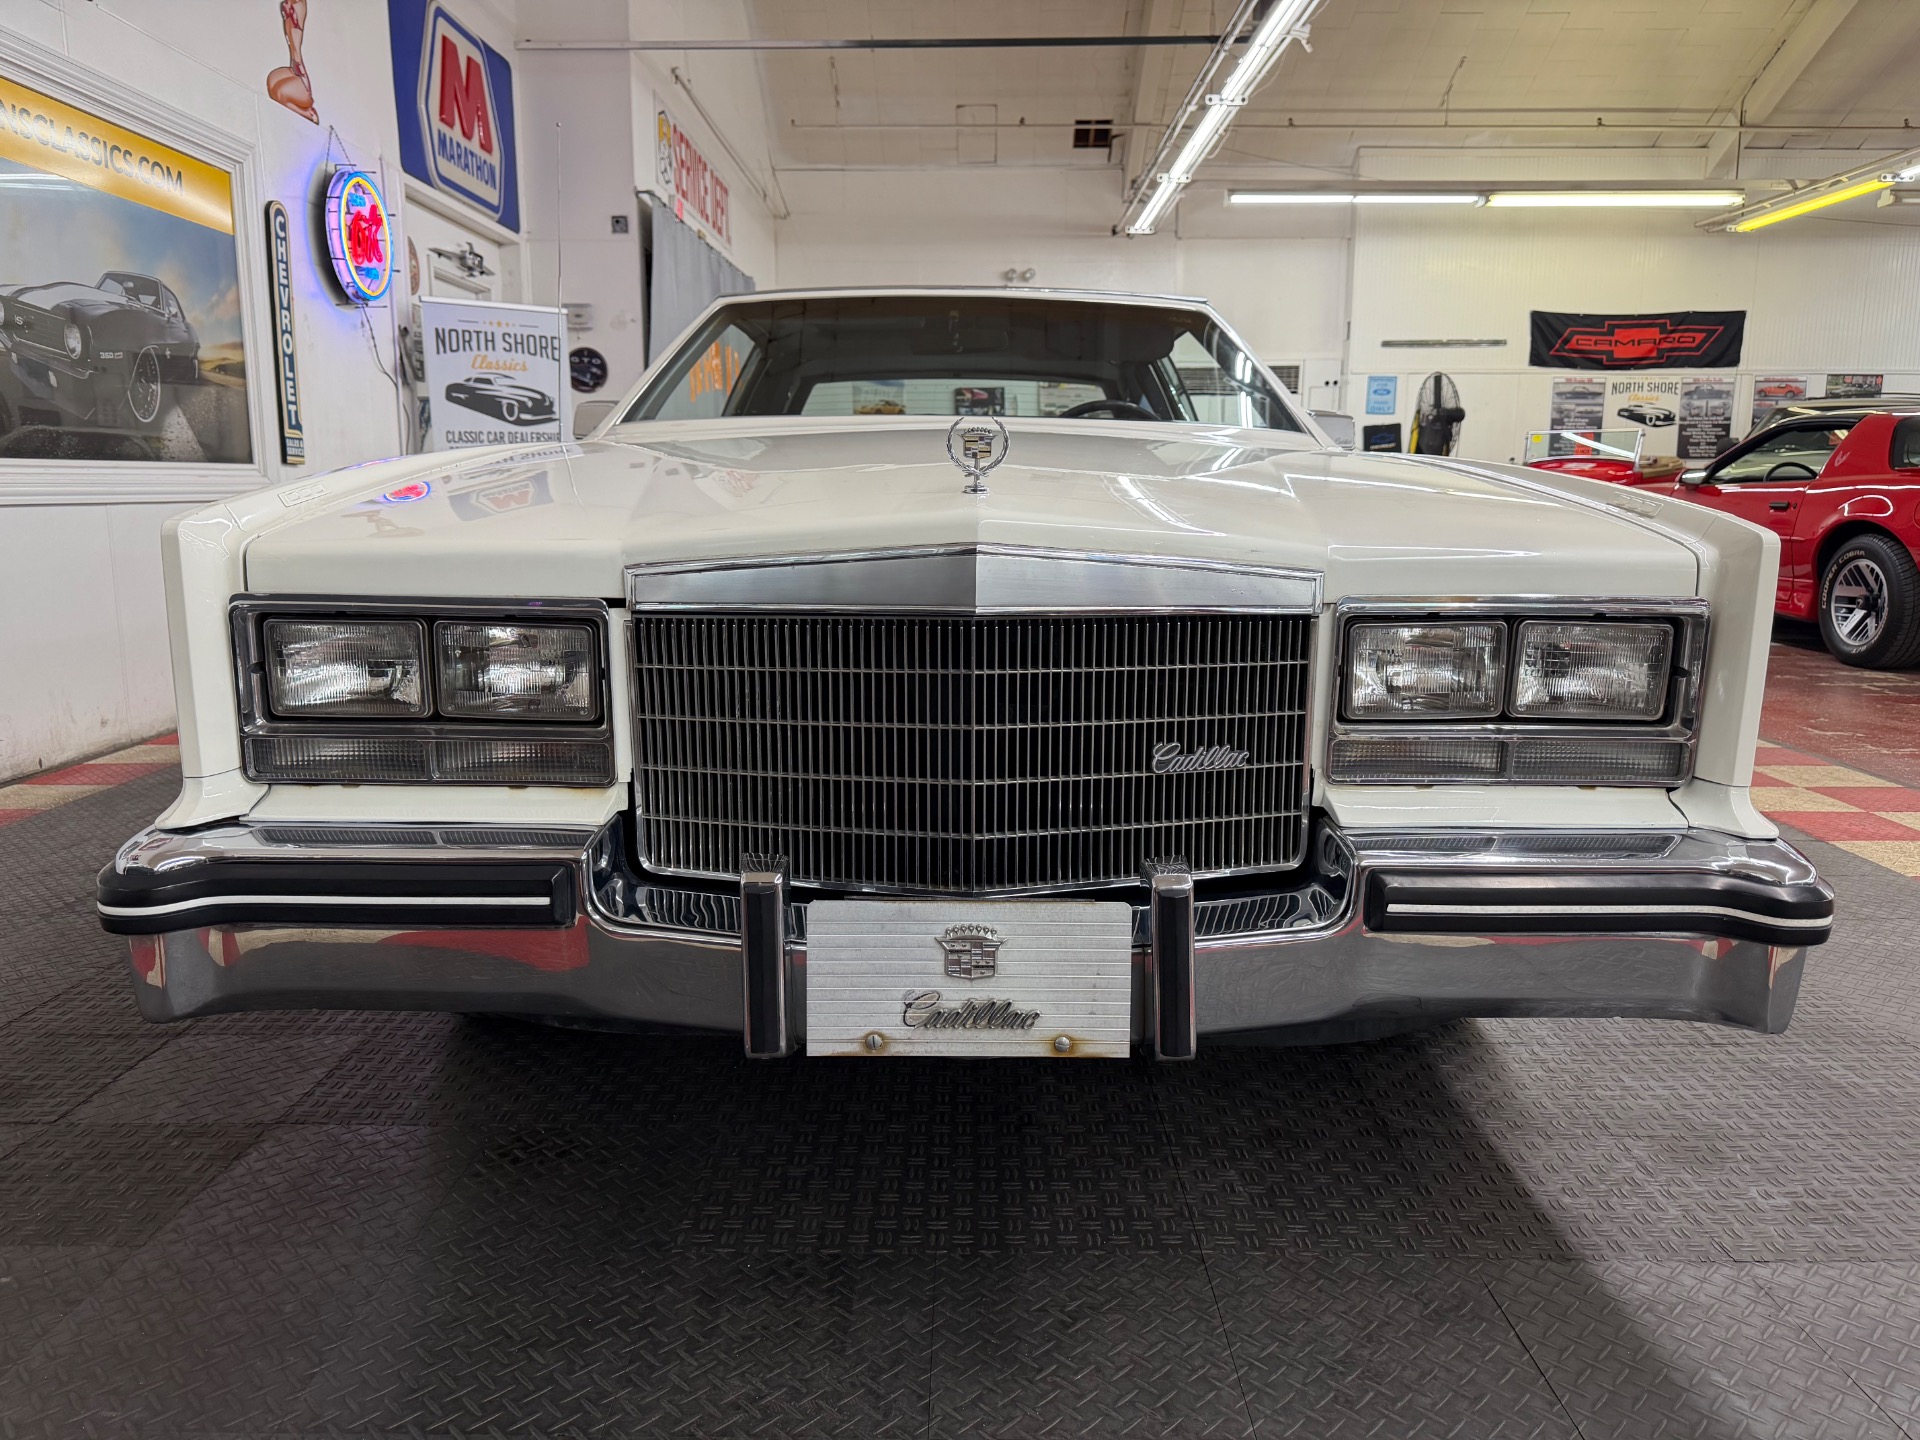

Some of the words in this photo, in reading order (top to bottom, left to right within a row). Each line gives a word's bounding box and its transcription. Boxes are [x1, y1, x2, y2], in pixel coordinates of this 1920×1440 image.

[439, 34, 493, 156] M
[437, 127, 497, 191] MARATHON
[275, 215, 297, 426] CHEVROLET
[435, 327, 496, 355] NORTH
[502, 331, 561, 362] SHORE
[1575, 334, 1697, 347] CAMARO
[471, 353, 529, 372] Classics
[1611, 382, 1644, 395] NORTH
[1647, 381, 1679, 395] SHORE
[446, 430, 484, 444] CLASSIC
[487, 431, 505, 443] CAR
[1821, 565, 1838, 609] COOPER
[1839, 549, 1866, 564] COBRA
[1152, 742, 1250, 774] Cadillac
[903, 989, 1040, 1029] Cadillac
